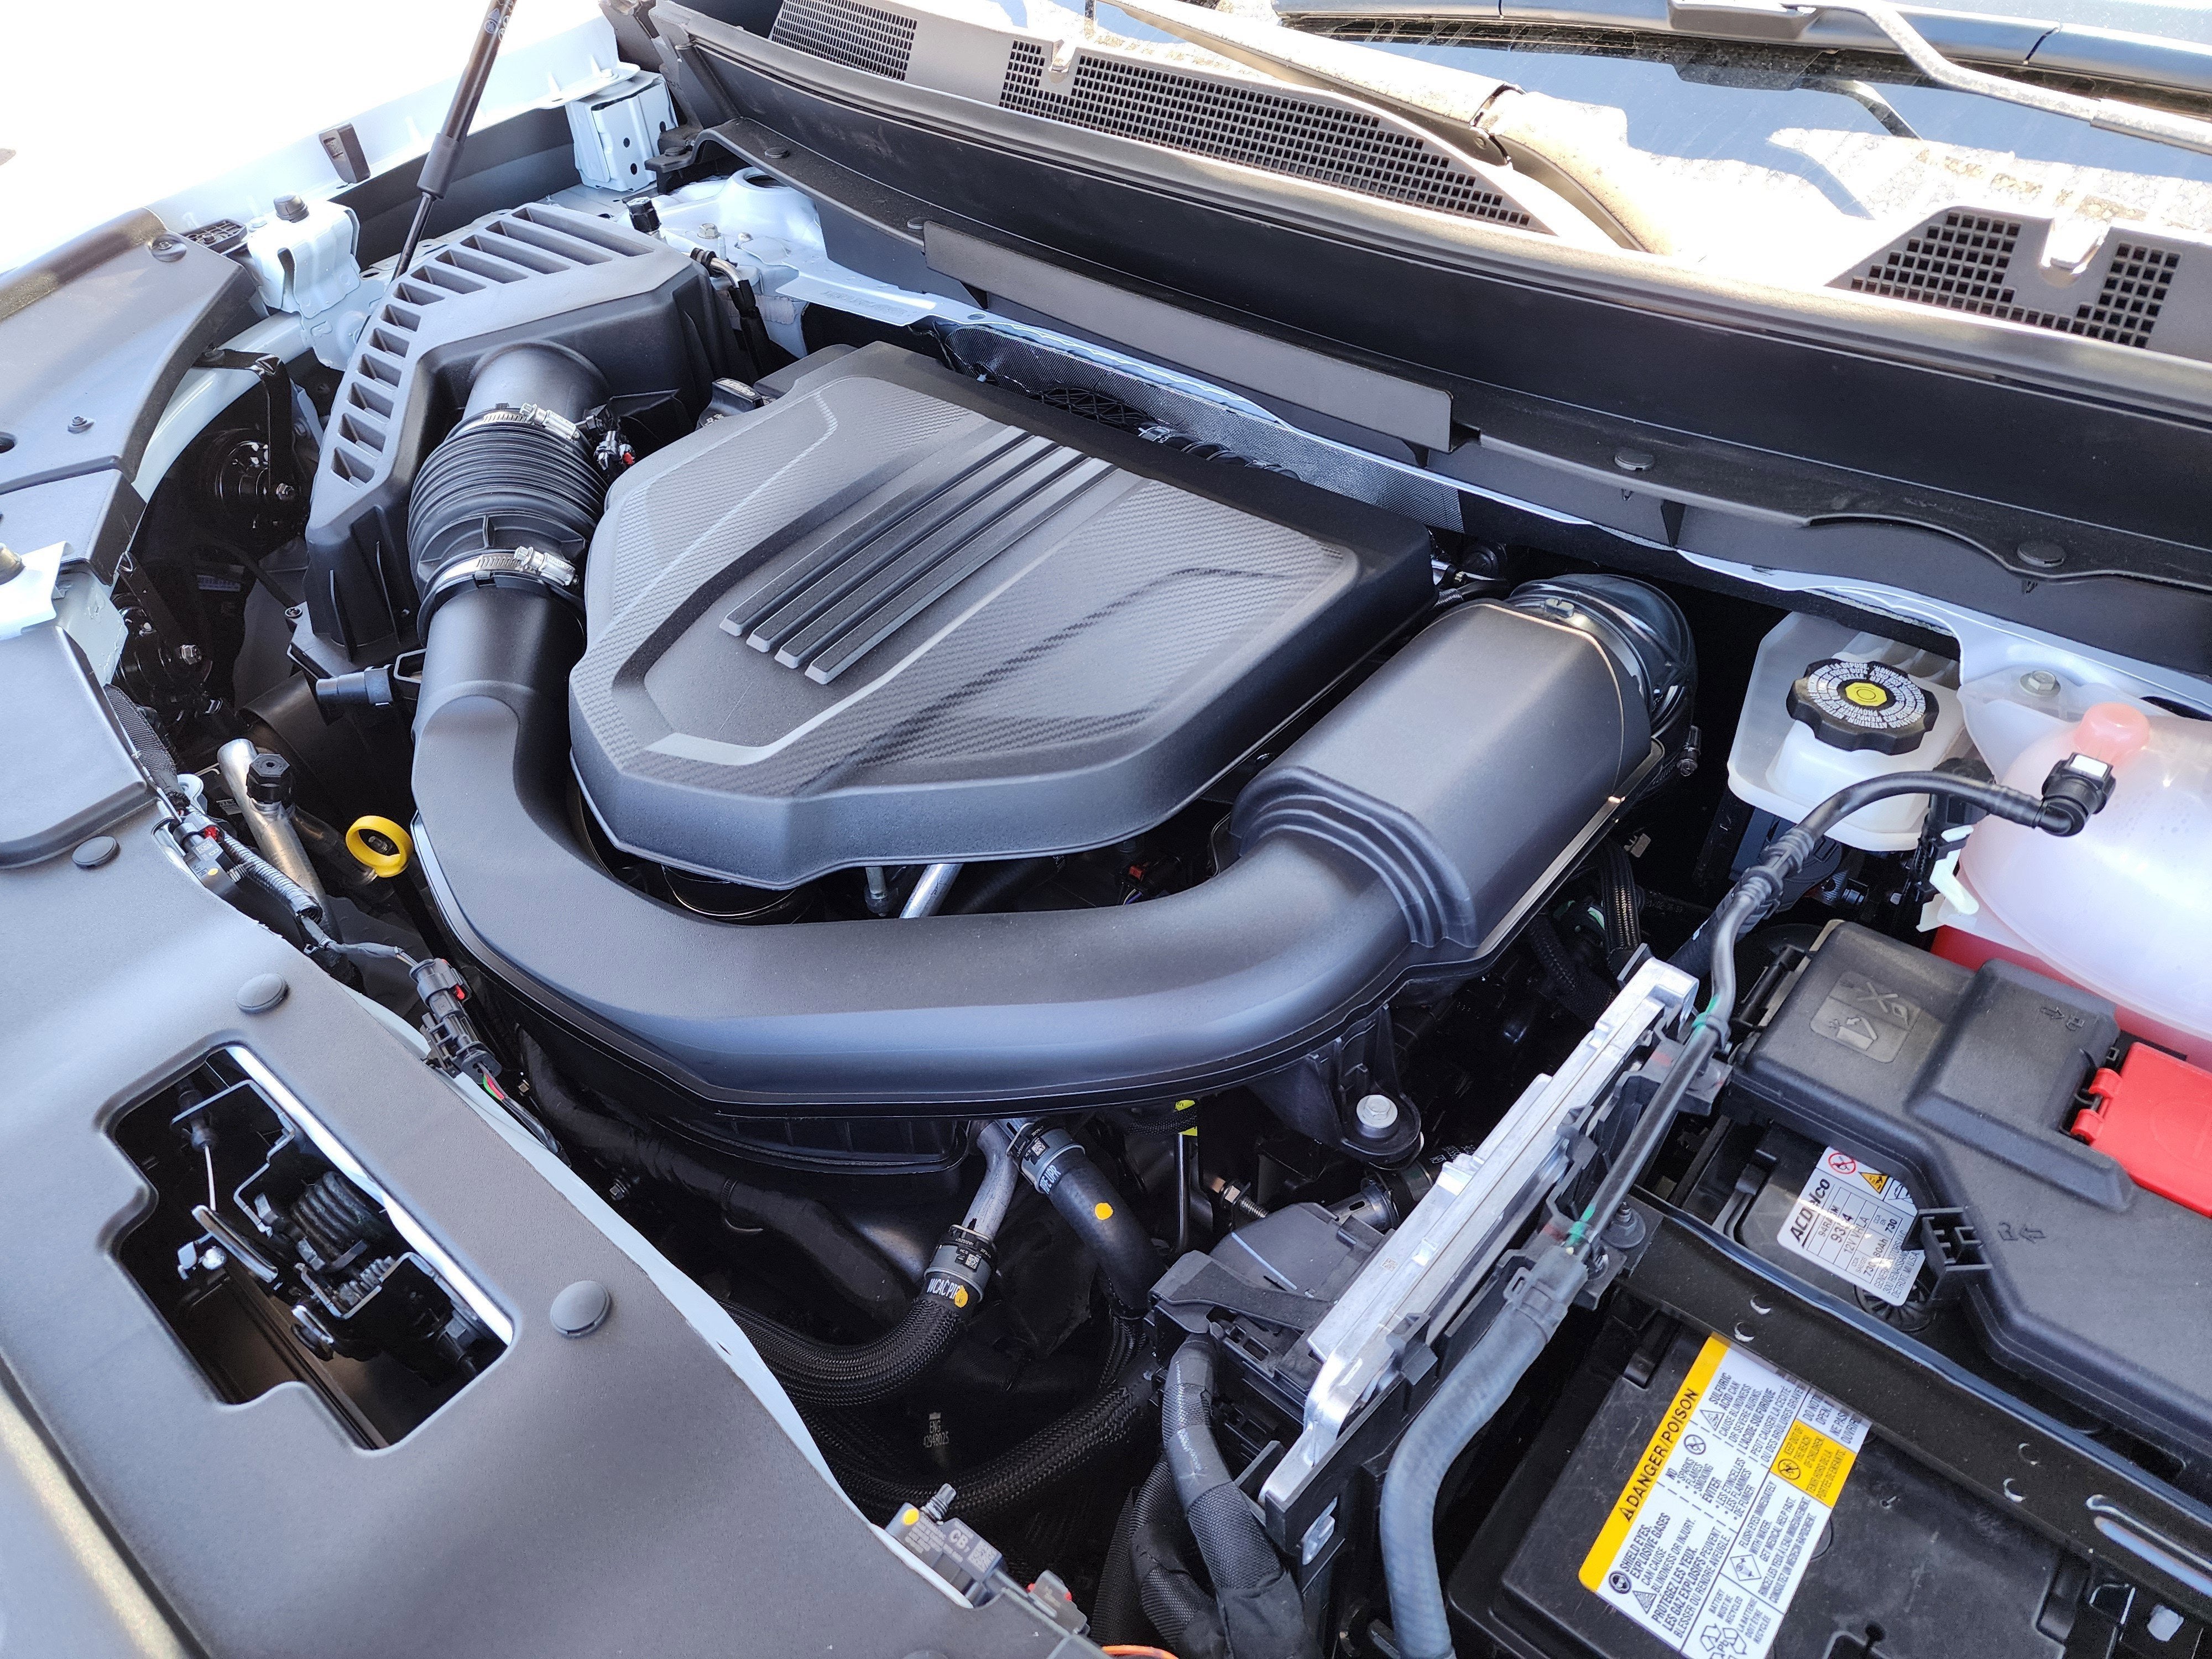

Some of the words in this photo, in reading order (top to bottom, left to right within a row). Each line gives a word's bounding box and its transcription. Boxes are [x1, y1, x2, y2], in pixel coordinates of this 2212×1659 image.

[1045, 1165, 1062, 1183] UPR
[1830, 1212, 1853, 1243] 934
[1844, 1238, 1857, 1254] 12V
[1854, 1215, 1869, 1240] VRLA
[1863, 1261, 1874, 1277] 730
[1873, 1238, 1888, 1258] 80Ah
[1885, 1218, 1897, 1233] 730
[1887, 1241, 1902, 1263] OTORS
[927, 1277, 950, 1297] WCAC
[1882, 1281, 1893, 1293] 300
[1709, 1373, 1731, 1405] SULFURIC
[1719, 1393, 1733, 1411] ACID
[1728, 1381, 1740, 1395] CAN
[1719, 1415, 1735, 1437] CAUSE
[1729, 1384, 1751, 1417] BLINDNESS
[1802, 1410, 1814, 1422] DO
[1807, 1396, 1822, 1412] NOT
[1815, 1406, 1832, 1425] OPEN.
[1733, 1408, 1751, 1433] SEVERE
[1738, 1424, 1757, 1450] L'ACIDE
[1750, 1388, 1776, 1427] SULFURIQUE
[1829, 1424, 1842, 1437] NE
[1834, 1411, 1848, 1426] PAS
[1728, 1432, 1740, 1443] OR
[1750, 1438, 1765, 1457] PEUT
[1759, 1415, 1777, 1440] CAUSER
[1770, 1407, 1781, 1417] LA
[1627, 1389, 1697, 1507] DANGER/POISON
[1760, 1451, 1772, 1463] OU
[1765, 1438, 1778, 1453] DES
[1793, 1450, 1805, 1462] THE
[1823, 1449, 1833, 1459] LA
[1665, 1468, 1678, 1480] NO
[1677, 1457, 1695, 1481] SPARKS
[1685, 1462, 1703, 1486] FLAMES
[1694, 1463, 1713, 1491] SMOKING
[1720, 1457, 1745, 1494] ÉTINCELLES
[1700, 1477, 1721, 1504] ÉVITER
[1730, 1468, 1751, 1499] FLAMMES
[1738, 1484, 1754, 1508] FUMER
[1715, 1492, 1728, 1506] LES
[1724, 1498, 1737, 1512] LES
[1733, 1505, 1745, 1517] DE
[1738, 1528, 1754, 1548] FLUSH
[1747, 1515, 1760, 1531] EYES
[1754, 1481, 1776, 1517] IMMEDIATELY
[1676, 1518, 1695, 1545] INJURY.
[1749, 1538, 1762, 1555] WITH
[1756, 1520, 1772, 1540] WATER.
[1759, 1548, 1770, 1562] GET
[1765, 1526, 1783, 1551] MEDICAL
[1776, 1510, 1788, 1527] HELP
[1782, 1496, 1796, 1512] FAST.
[1620, 1544, 1640, 1572] SHIELD
[1633, 1524, 1652, 1546] EYES.
[1630, 1536, 1658, 1579] EXPLOSIVE
[1651, 1512, 1670, 1538] GASES
[1671, 1543, 1682, 1555] OR
[1641, 1569, 1655, 1586] CAN
[1648, 1546, 1667, 1571] CAUSE
[1771, 1552, 1785, 1568] YEUX
[1782, 1565, 1792, 1575] UN
[1651, 1553, 1677, 1593] BLINDNESS
[1651, 1582, 1679, 1624] PROTÉGEZ
[1671, 1567, 1686, 1584] LES
[1679, 1546, 1698, 1568] YEUX.
[1662, 1614, 1677, 1631] LES
[1670, 1597, 1686, 1616] GAZ
[1678, 1557, 1705, 1599] EXPLOSIFS
[1699, 1526, 1720, 1559] PEUVENT
[1766, 1567, 1778, 1579] LES
[1673, 1605, 1695, 1639] BLESSER
[1689, 1593, 1701, 1606] OU
[1695, 1565, 1715, 1595] RENDRE
[1709, 1535, 1730, 1568] AVEUGLE.
[1708, 1588, 1724, 1614] BATTERY
[1717, 1601, 1729, 1619] MUST
[1724, 1594, 1733, 1604] BE
[1725, 1596, 1743, 1625] RECYCLED
[1740, 1598, 1757, 1625] BATTERIE
[1736, 1623, 1745, 1633] LA
[1717, 1640, 1729, 1653] Pb
